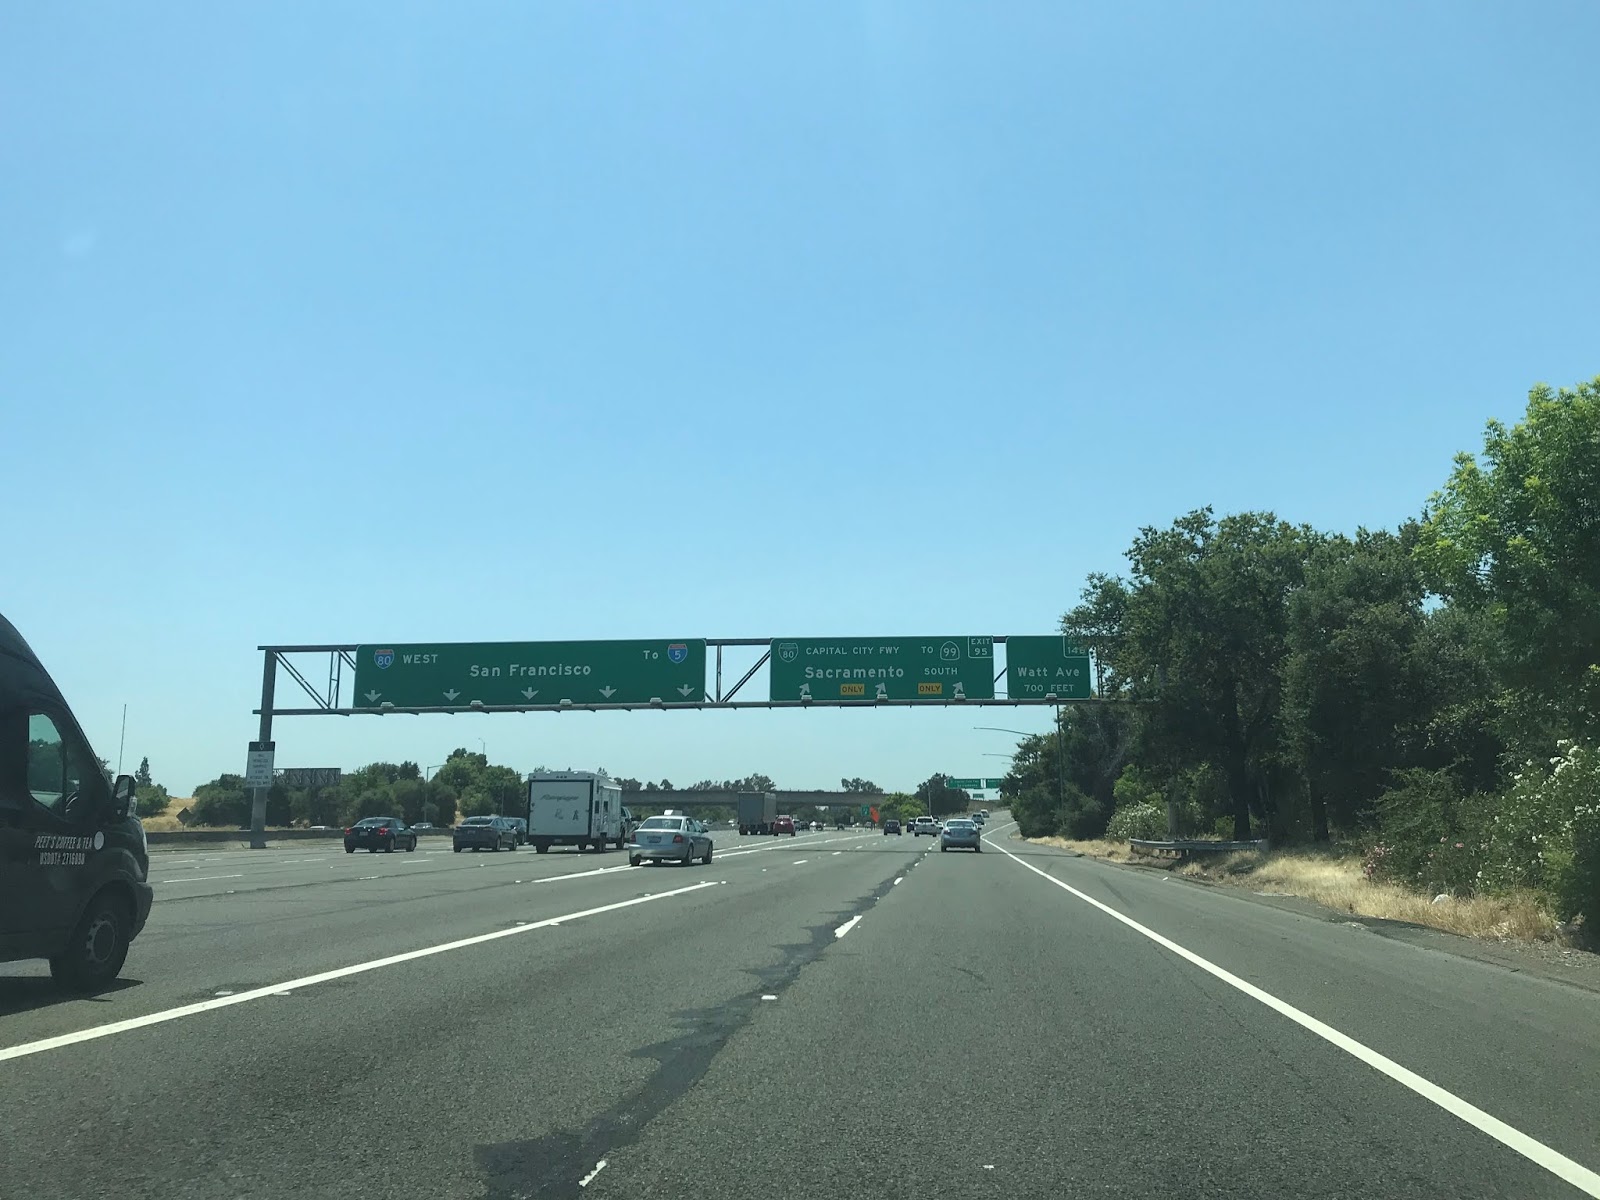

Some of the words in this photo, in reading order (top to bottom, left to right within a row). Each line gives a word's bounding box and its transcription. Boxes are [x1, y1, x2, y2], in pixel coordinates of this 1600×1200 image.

[643, 650, 659, 660] To
[674, 650, 680, 660] 5
[782, 650, 794, 660] 80
[806, 647, 848, 656] CAPITAL
[852, 646, 874, 655] CITY
[880, 646, 900, 655] FWY
[944, 648, 957, 657] 99
[974, 648, 988, 656] 95
[378, 656, 391, 666] 80
[402, 654, 438, 664] WEST
[470, 664, 500, 677] San
[509, 663, 592, 677] Francisco
[804, 666, 904, 679] Sacramento
[924, 667, 958, 676] SOUTH
[1017, 666, 1048, 677] Watt
[1056, 667, 1080, 677] Ave
[1050, 684, 1074, 692] FEET
[56, 836, 76, 849] COFFEE
[82, 837, 92, 849] TEA
